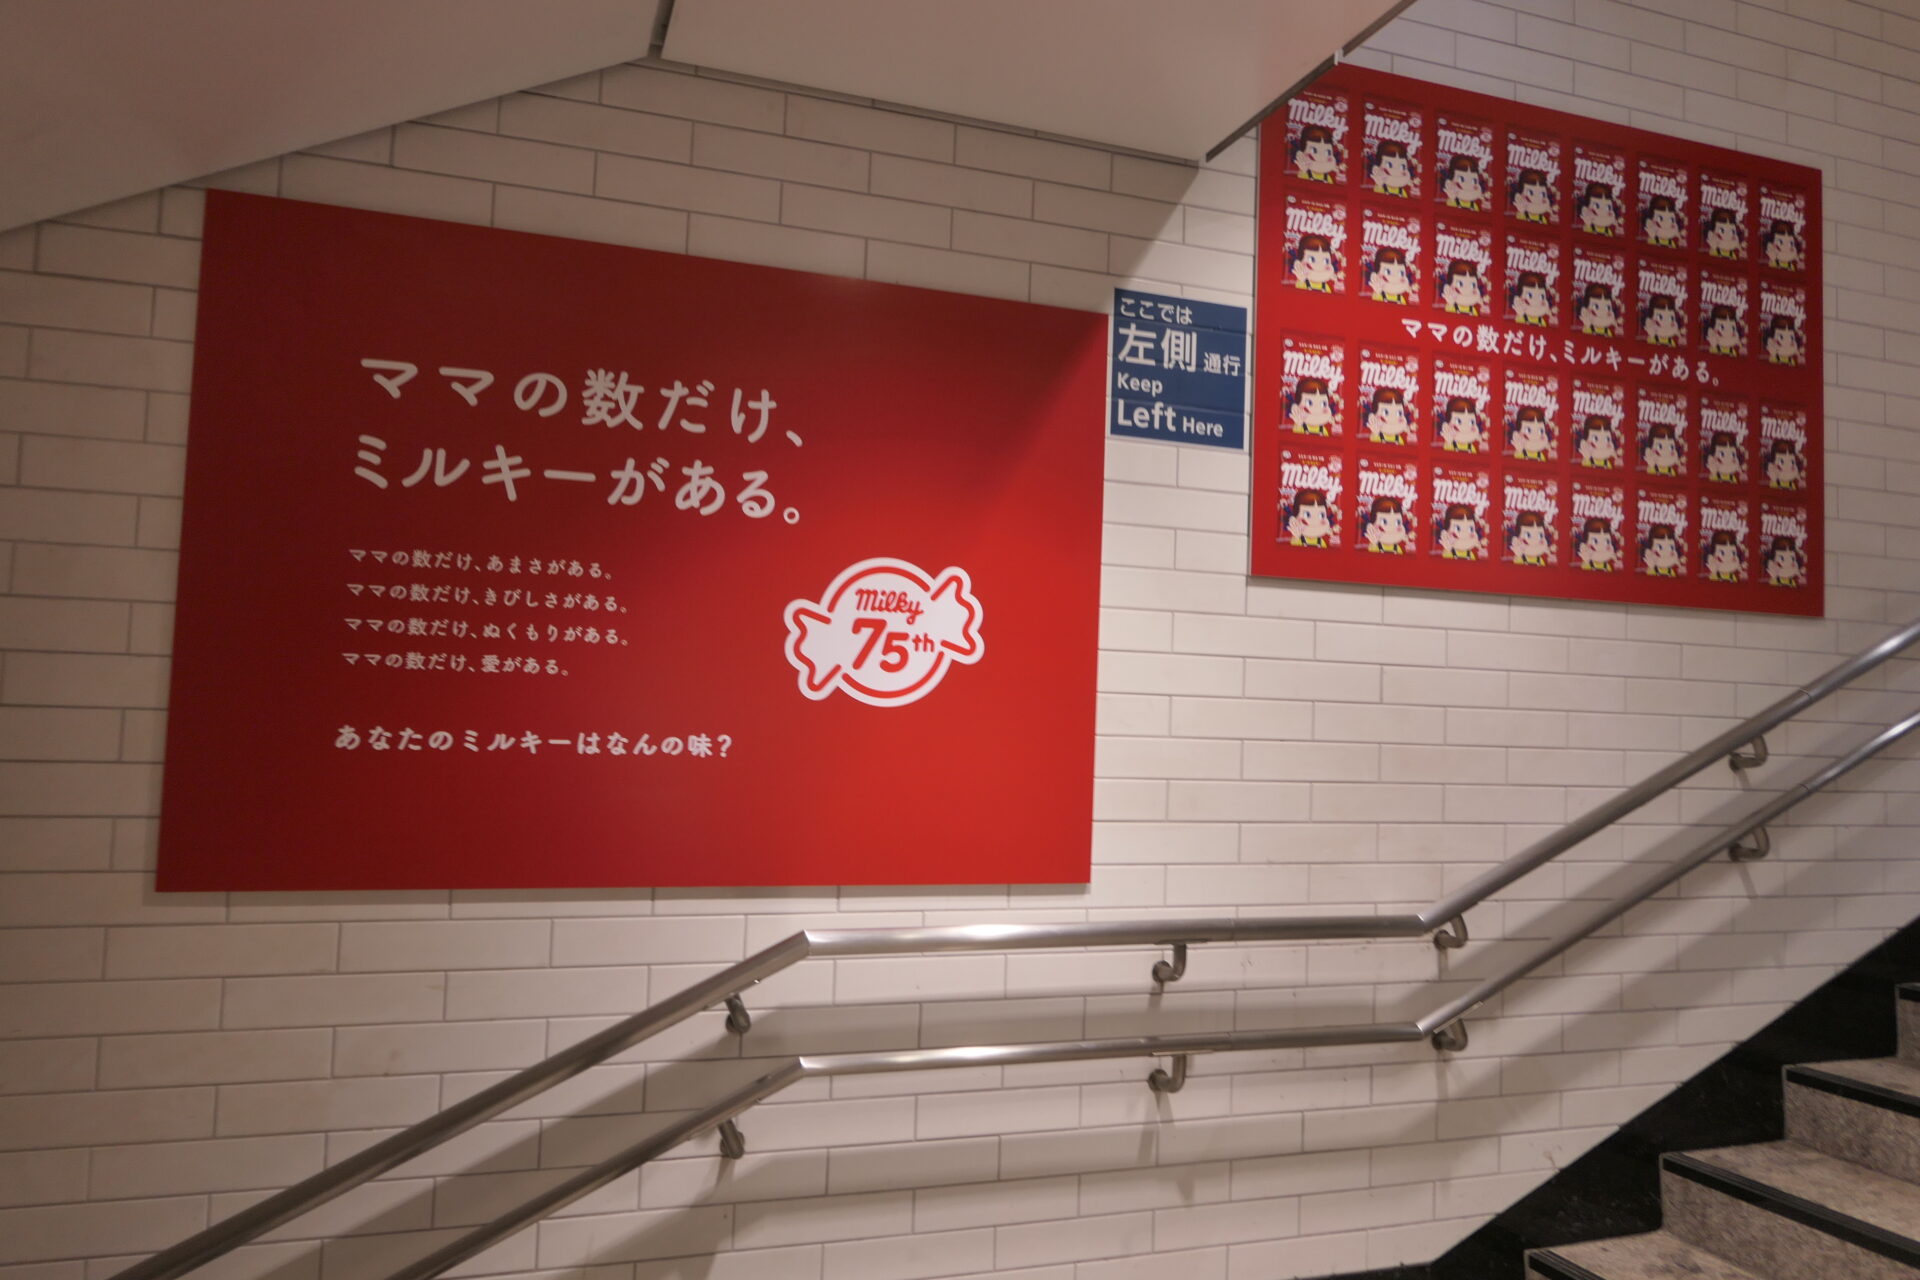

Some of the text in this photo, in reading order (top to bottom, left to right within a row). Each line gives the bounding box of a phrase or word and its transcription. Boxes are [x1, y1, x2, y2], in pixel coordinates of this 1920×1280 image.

[1120, 297, 1193, 325] ここでは
[1118, 323, 1241, 376] 左側 通行
[1401, 318, 1719, 386] ママの数だけ、ミルキーがある。
[1117, 372, 1163, 397] Keep
[361, 358, 804, 448] ママの数だけ、
[1117, 398, 1224, 437] Left Here
[355, 434, 800, 525] ミルキーがある。
[349, 549, 612, 580] ママの数だけ、あまさがある。
[346, 583, 628, 613] ママの数だけ、きびしさがある。
[855, 589, 923, 625] Milky
[344, 617, 628, 646] ママの数だけ、ぬくもりがある。
[852, 617, 934, 672] 75th
[342, 652, 569, 677] ママの数だけ、愛がある。
[335, 725, 732, 758] あなたのミルキーはなんの味?
